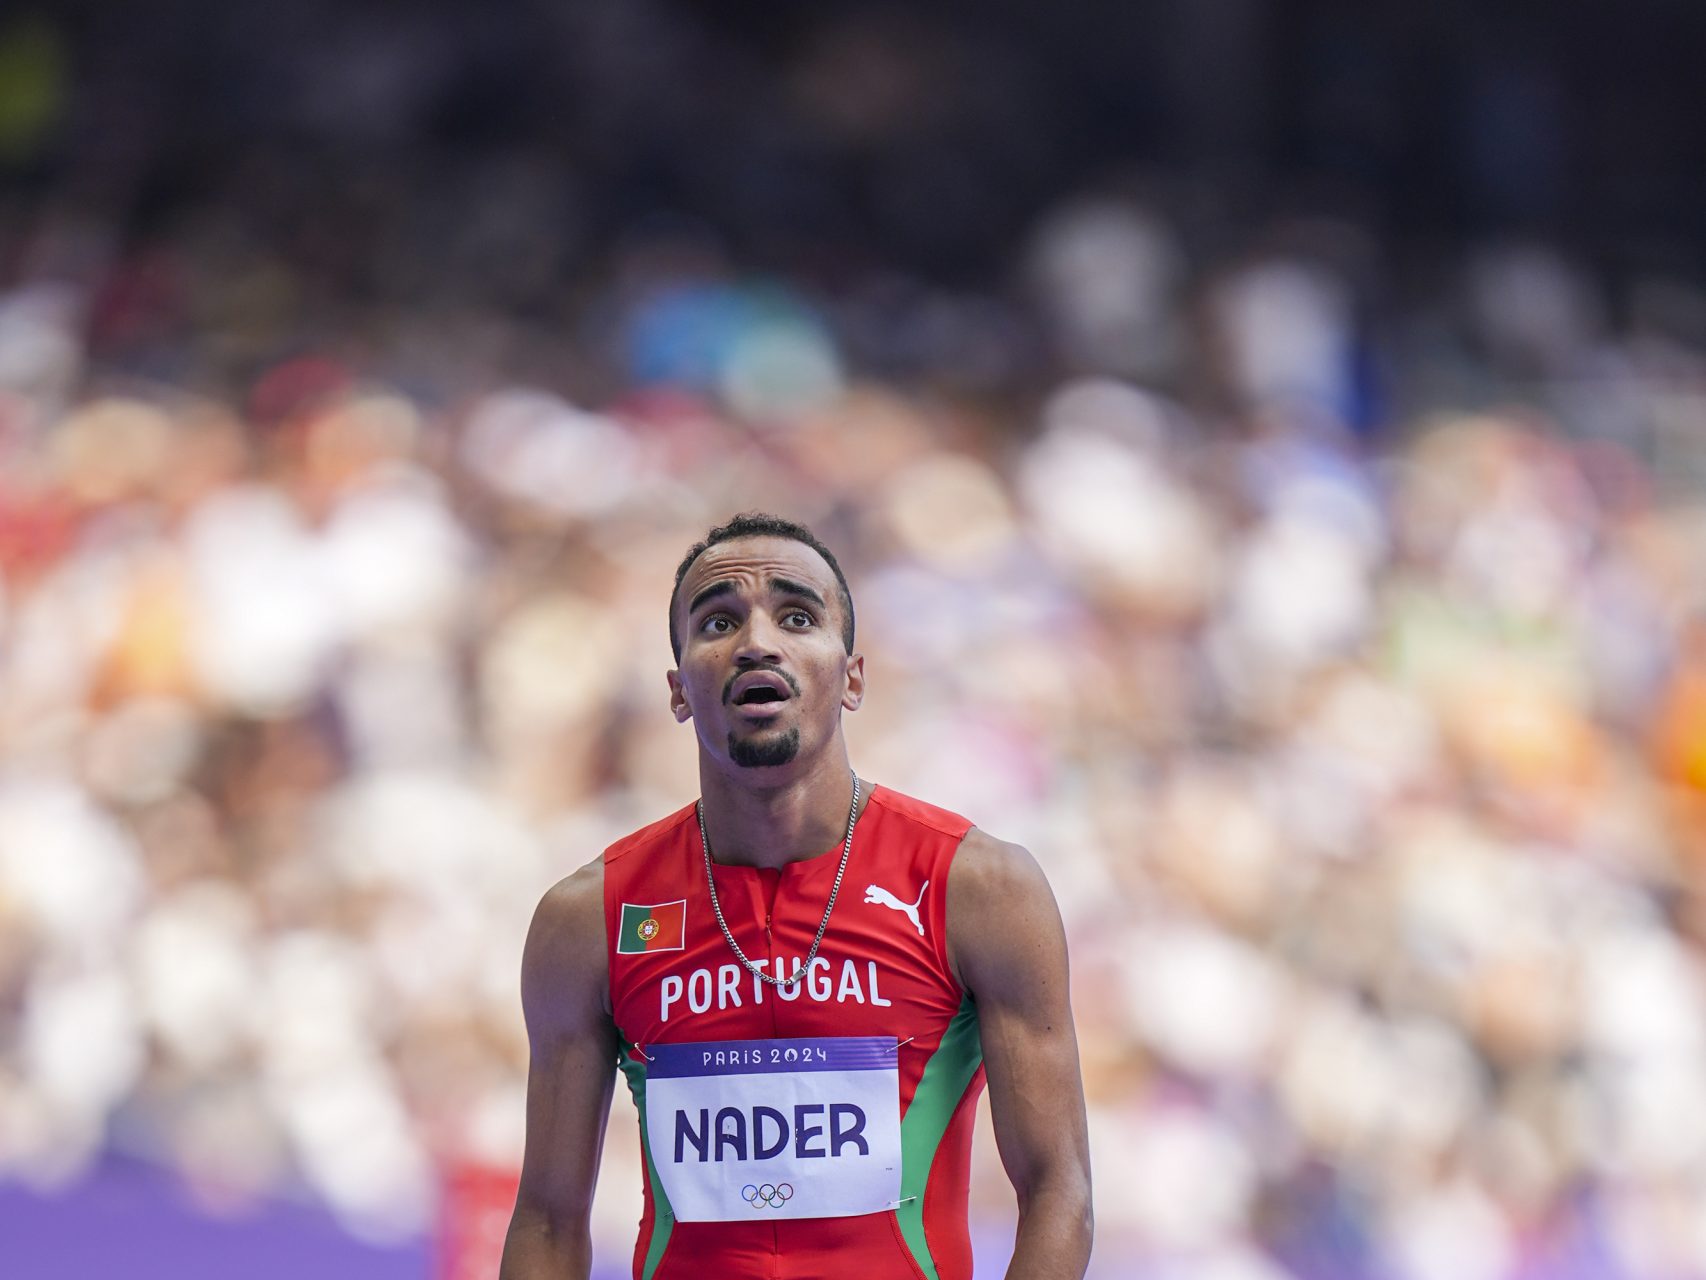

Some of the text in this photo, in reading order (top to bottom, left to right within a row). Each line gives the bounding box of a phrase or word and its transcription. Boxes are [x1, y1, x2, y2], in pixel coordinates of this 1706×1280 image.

[660, 956, 892, 1022] PORTUGAL
[770, 1047, 827, 1064] 2024
[674, 1103, 869, 1163] NADER
